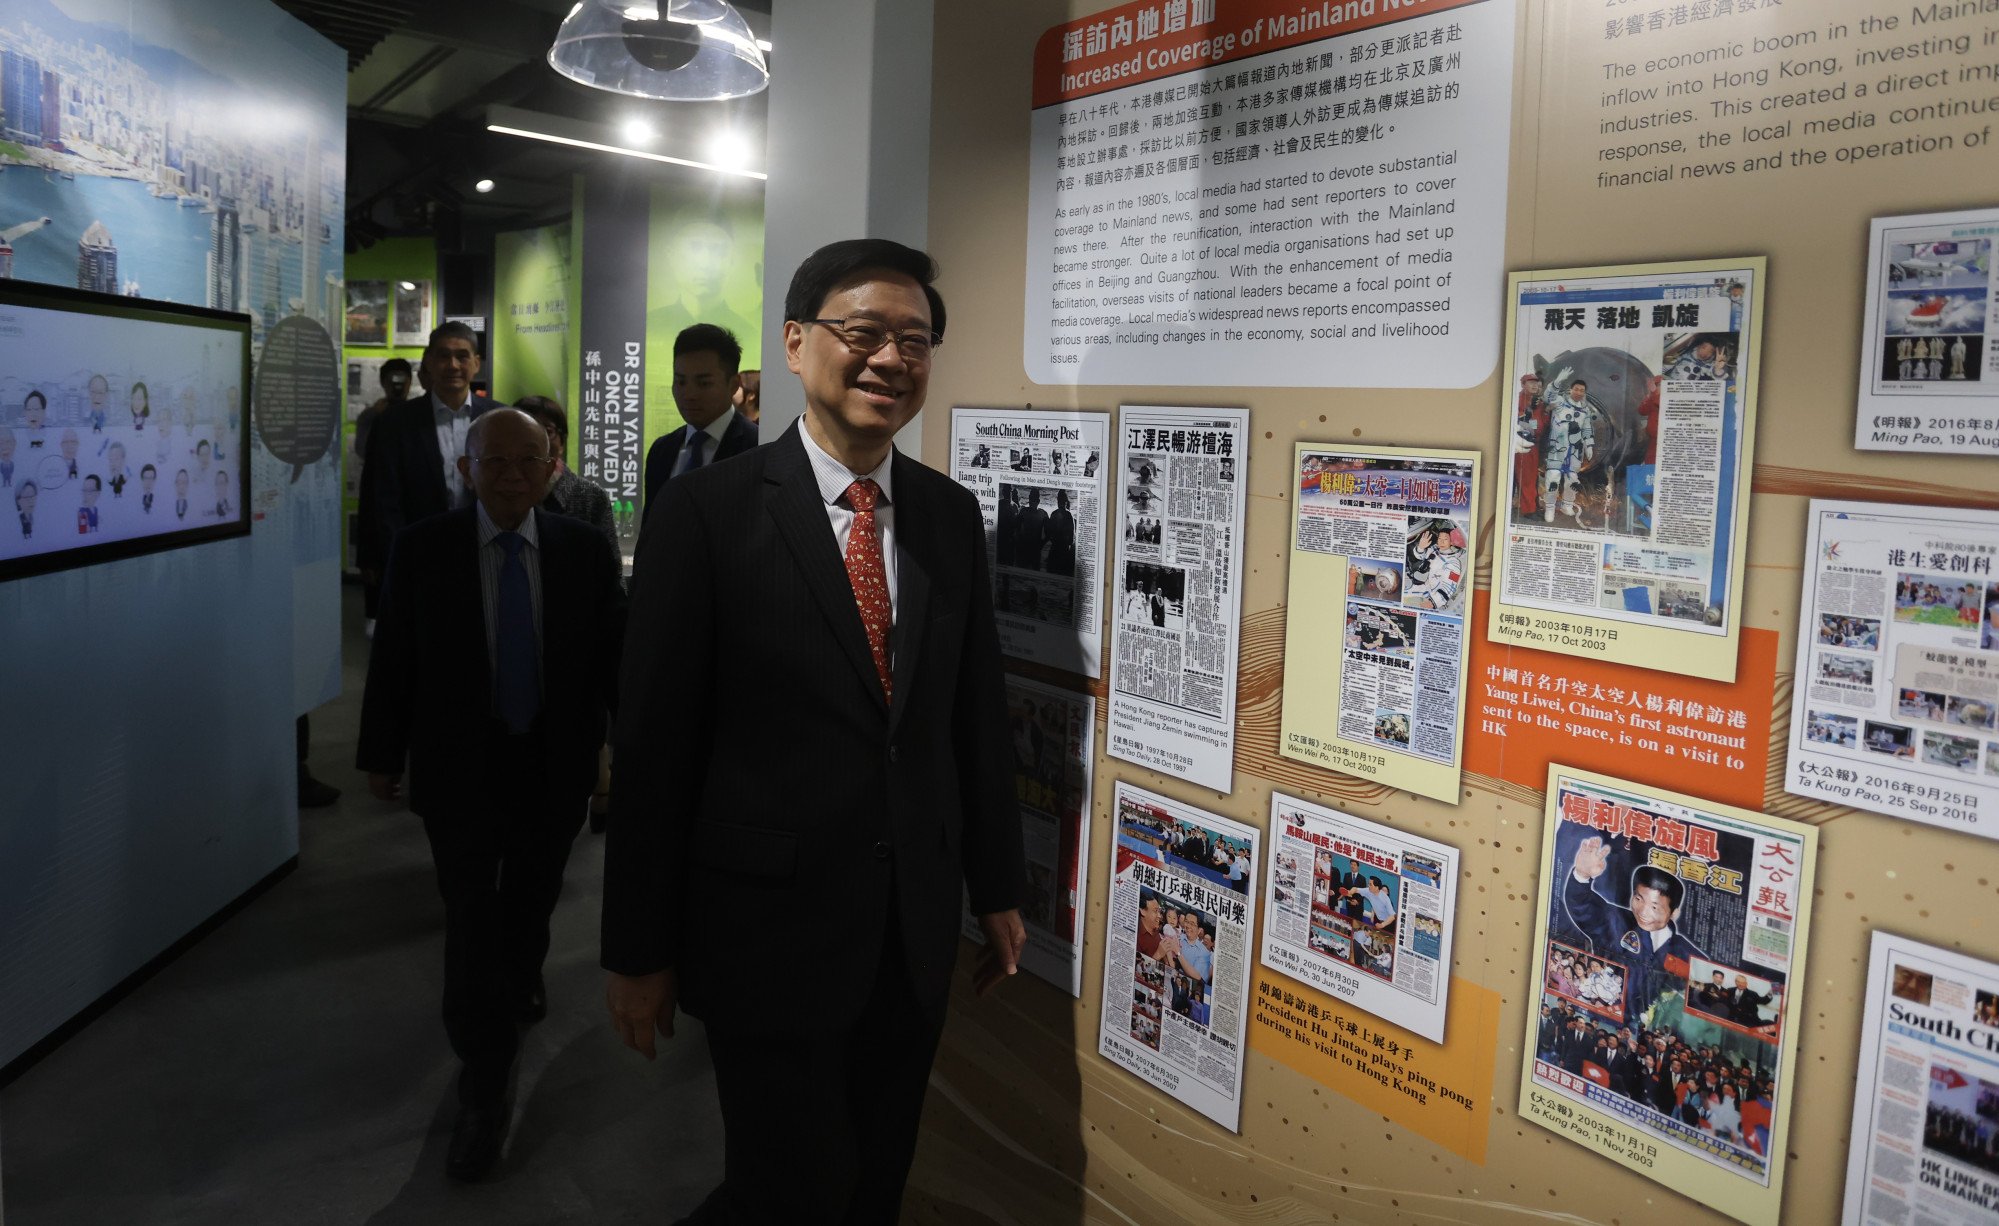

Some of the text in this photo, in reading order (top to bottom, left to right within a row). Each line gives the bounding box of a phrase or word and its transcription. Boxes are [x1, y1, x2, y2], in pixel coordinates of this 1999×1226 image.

[1062, 51, 1142, 91] Increased
[1146, 33, 1236, 70] Coverage
[1241, 18, 1264, 46] of
[1602, 87, 1658, 107] inflow
[1667, 80, 1703, 97] into
[1713, 69, 1768, 89] Hong
[1780, 58, 1843, 78] Kong,
[1856, 36, 1970, 66] investing
[1603, 63, 1636, 80] The
[1645, 42, 1743, 73] economic
[1753, 30, 1816, 53] boom
[1828, 23, 1847, 40] in
[1860, 15, 1899, 35] the
[1600, 109, 1698, 134] industries.
[1710, 98, 1752, 118] This
[1760, 82, 1846, 111] created
[1854, 84, 1867, 98] a
[1877, 69, 1948, 94] direct
[1597, 126, 1990, 188] financial news and the operation of
[1599, 139, 1686, 162] response,
[1698, 131, 1731, 149] the
[1743, 120, 1791, 143] local
[1804, 110, 1875, 135] media
[1052, 208, 1066, 220] As
[1069, 204, 1090, 217] early
[1093, 204, 1104, 214] as
[1106, 201, 1115, 211] in
[1118, 198, 1133, 210] the
[1175, 187, 1198, 202] local
[1202, 182, 1236, 198] media
[1240, 178, 1261, 193] had
[1265, 172, 1308, 190] started
[1312, 172, 1324, 183] to
[1329, 165, 1374, 181] devote
[1379, 149, 1456, 174] substantial
[1544, 303, 1700, 331] 飛天 落地 凱旋
[1050, 352, 1080, 364] issues.
[583, 350, 602, 484] 孫中山先生與此
[604, 370, 621, 425] ONCE
[622, 341, 640, 497] DR SUN YAT-SEN
[603, 429, 620, 483] LIVED
[975, 422, 1079, 443] South China Morning Post
[1872, 432, 1908, 445] Ming
[1912, 433, 1942, 445] Pao,
[1950, 434, 1965, 445] 19
[958, 471, 977, 484] Jiang
[978, 473, 993, 485] trip
[980, 488, 996, 498] with
[1498, 626, 1606, 651] Ming Pao, 17 Oct 2003
[1499, 613, 1618, 640] 《明報》 2003年10月17日
[1121, 702, 1137, 714] Hong
[1139, 707, 1155, 719] Kong
[1157, 713, 1182, 725] reporter
[1184, 719, 1196, 729] has
[1198, 725, 1228, 738] captured
[1485, 684, 1746, 750] Yang Liwei, China's first astronaut
[1487, 665, 1747, 729] 中國首名升空太空人楊利偉訪港
[1114, 709, 1227, 748] President Jiang Zemin swimming in
[1482, 720, 1507, 737] HK
[1483, 705, 1744, 770] sent to the space, is on a visit to
[1799, 761, 1977, 808] 《大公報》 2016年9月25日
[1799, 776, 1977, 823] Ta Kung Pao, 25 Sep 2016
[1561, 791, 1720, 862] 楊利偉旋風
[1755, 841, 1795, 913] 大公報
[1888, 1001, 1962, 1042] South
[1256, 1013, 1426, 1105] during his visit to Hong Kong
[1258, 996, 1473, 1111] President Hu Jintao plays ping pong
[1919, 1171, 1941, 1188] ON
[1920, 1157, 1980, 1190] HK LINK
